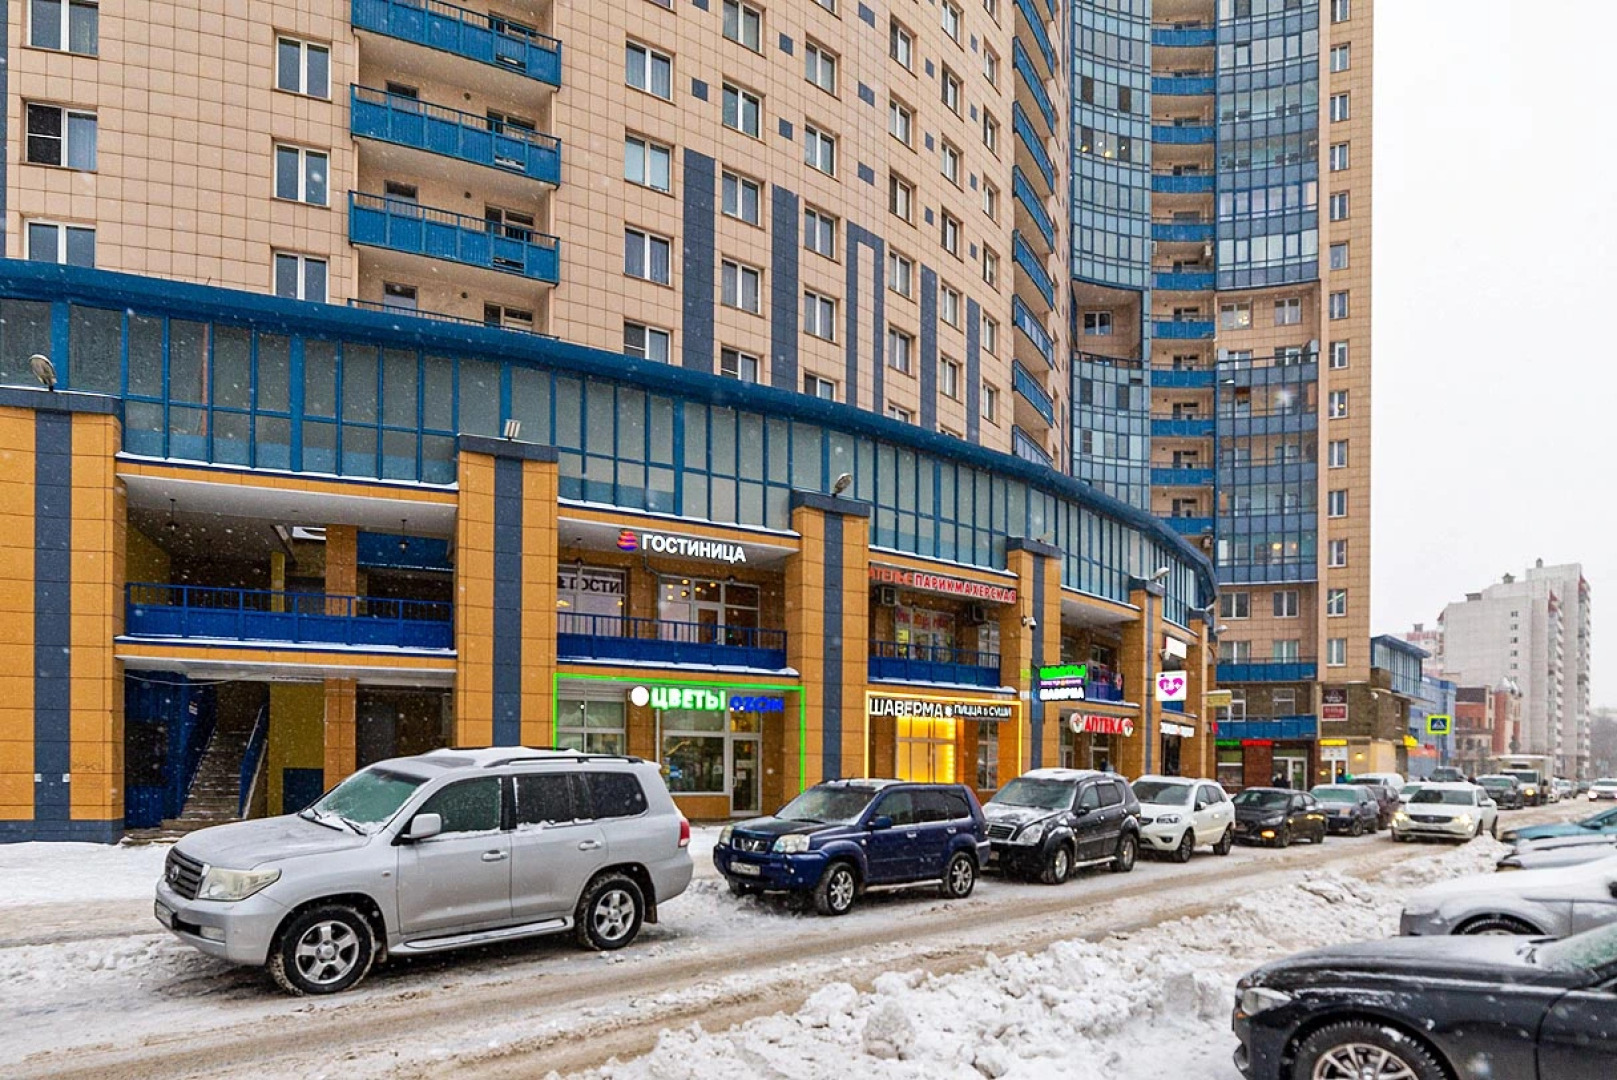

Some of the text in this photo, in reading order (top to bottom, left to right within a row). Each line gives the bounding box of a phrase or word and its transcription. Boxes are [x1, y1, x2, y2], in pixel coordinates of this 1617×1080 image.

[641, 534, 747, 564] ГОСТИНИЦА
[915, 573, 1017, 604] ПАРИКМАХЕРСКАЯ
[651, 686, 726, 710] ЦВЕТЫ
[730, 694, 785, 714] OZON
[869, 698, 944, 718] ШАВЕРМА
[1085, 714, 1124, 735] АПТЕКА
